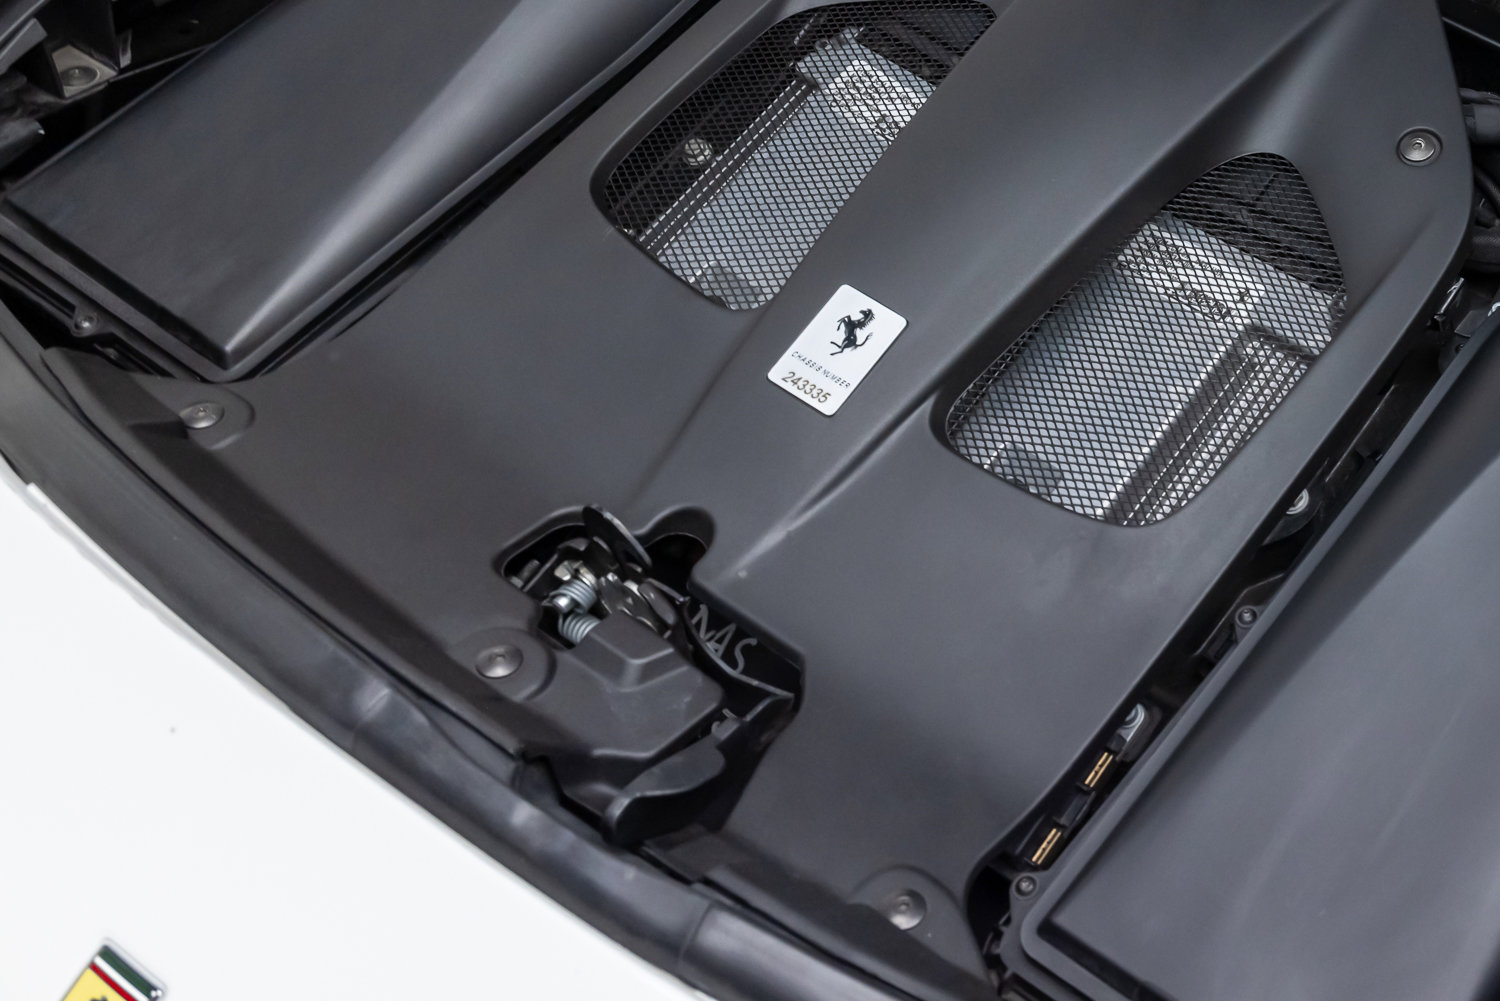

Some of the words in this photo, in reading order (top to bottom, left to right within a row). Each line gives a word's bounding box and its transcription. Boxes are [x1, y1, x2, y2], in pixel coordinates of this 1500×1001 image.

[781, 371, 832, 403] 243335
[791, 351, 823, 372] CHASSIS
[822, 369, 851, 389] NUMBER
